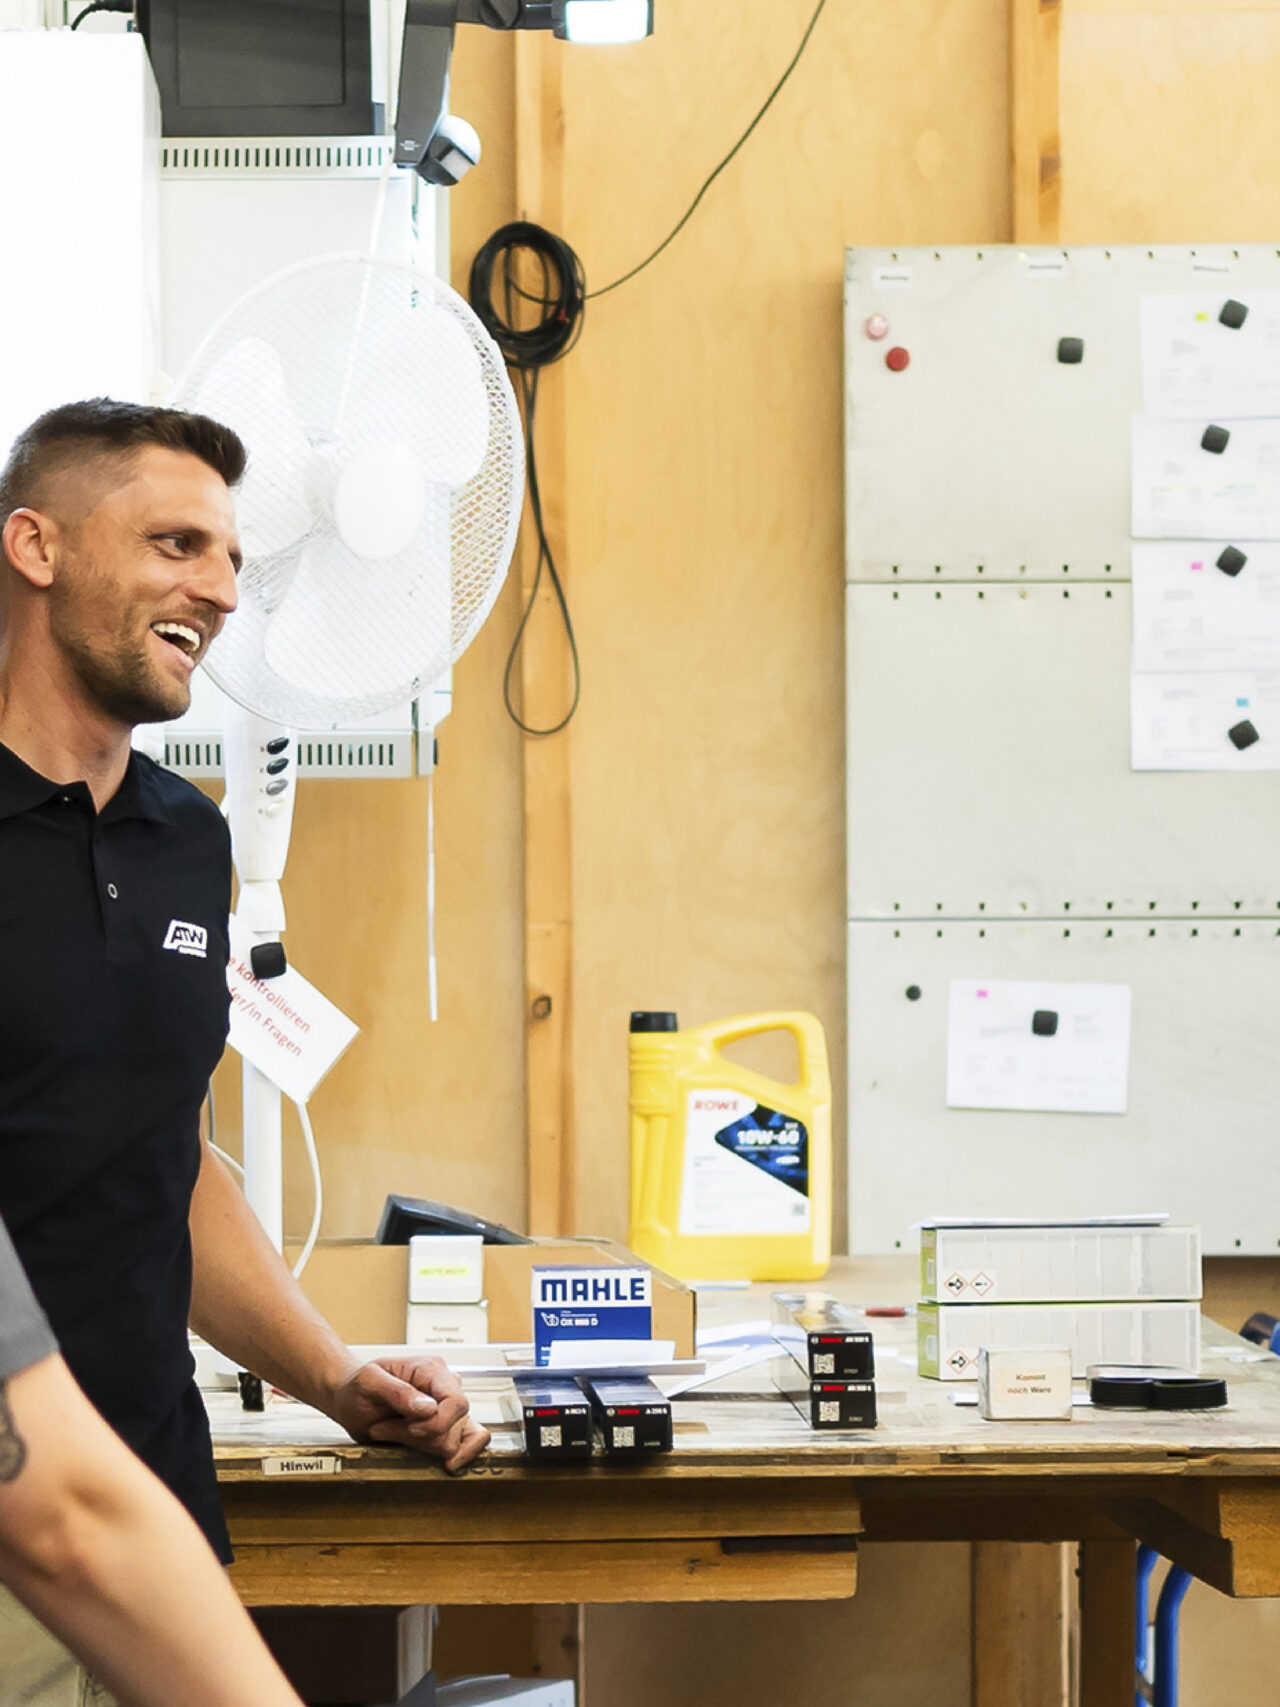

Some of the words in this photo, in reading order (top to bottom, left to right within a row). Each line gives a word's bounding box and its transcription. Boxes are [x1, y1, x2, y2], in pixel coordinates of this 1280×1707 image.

[236, 962, 311, 1033] kontrollieren
[231, 986, 262, 1021] er/in
[262, 1018, 303, 1057] Fragen
[694, 1100, 740, 1111] ROWE
[540, 1277, 645, 1303] MAHLE
[279, 1459, 324, 1472] Hinwil
